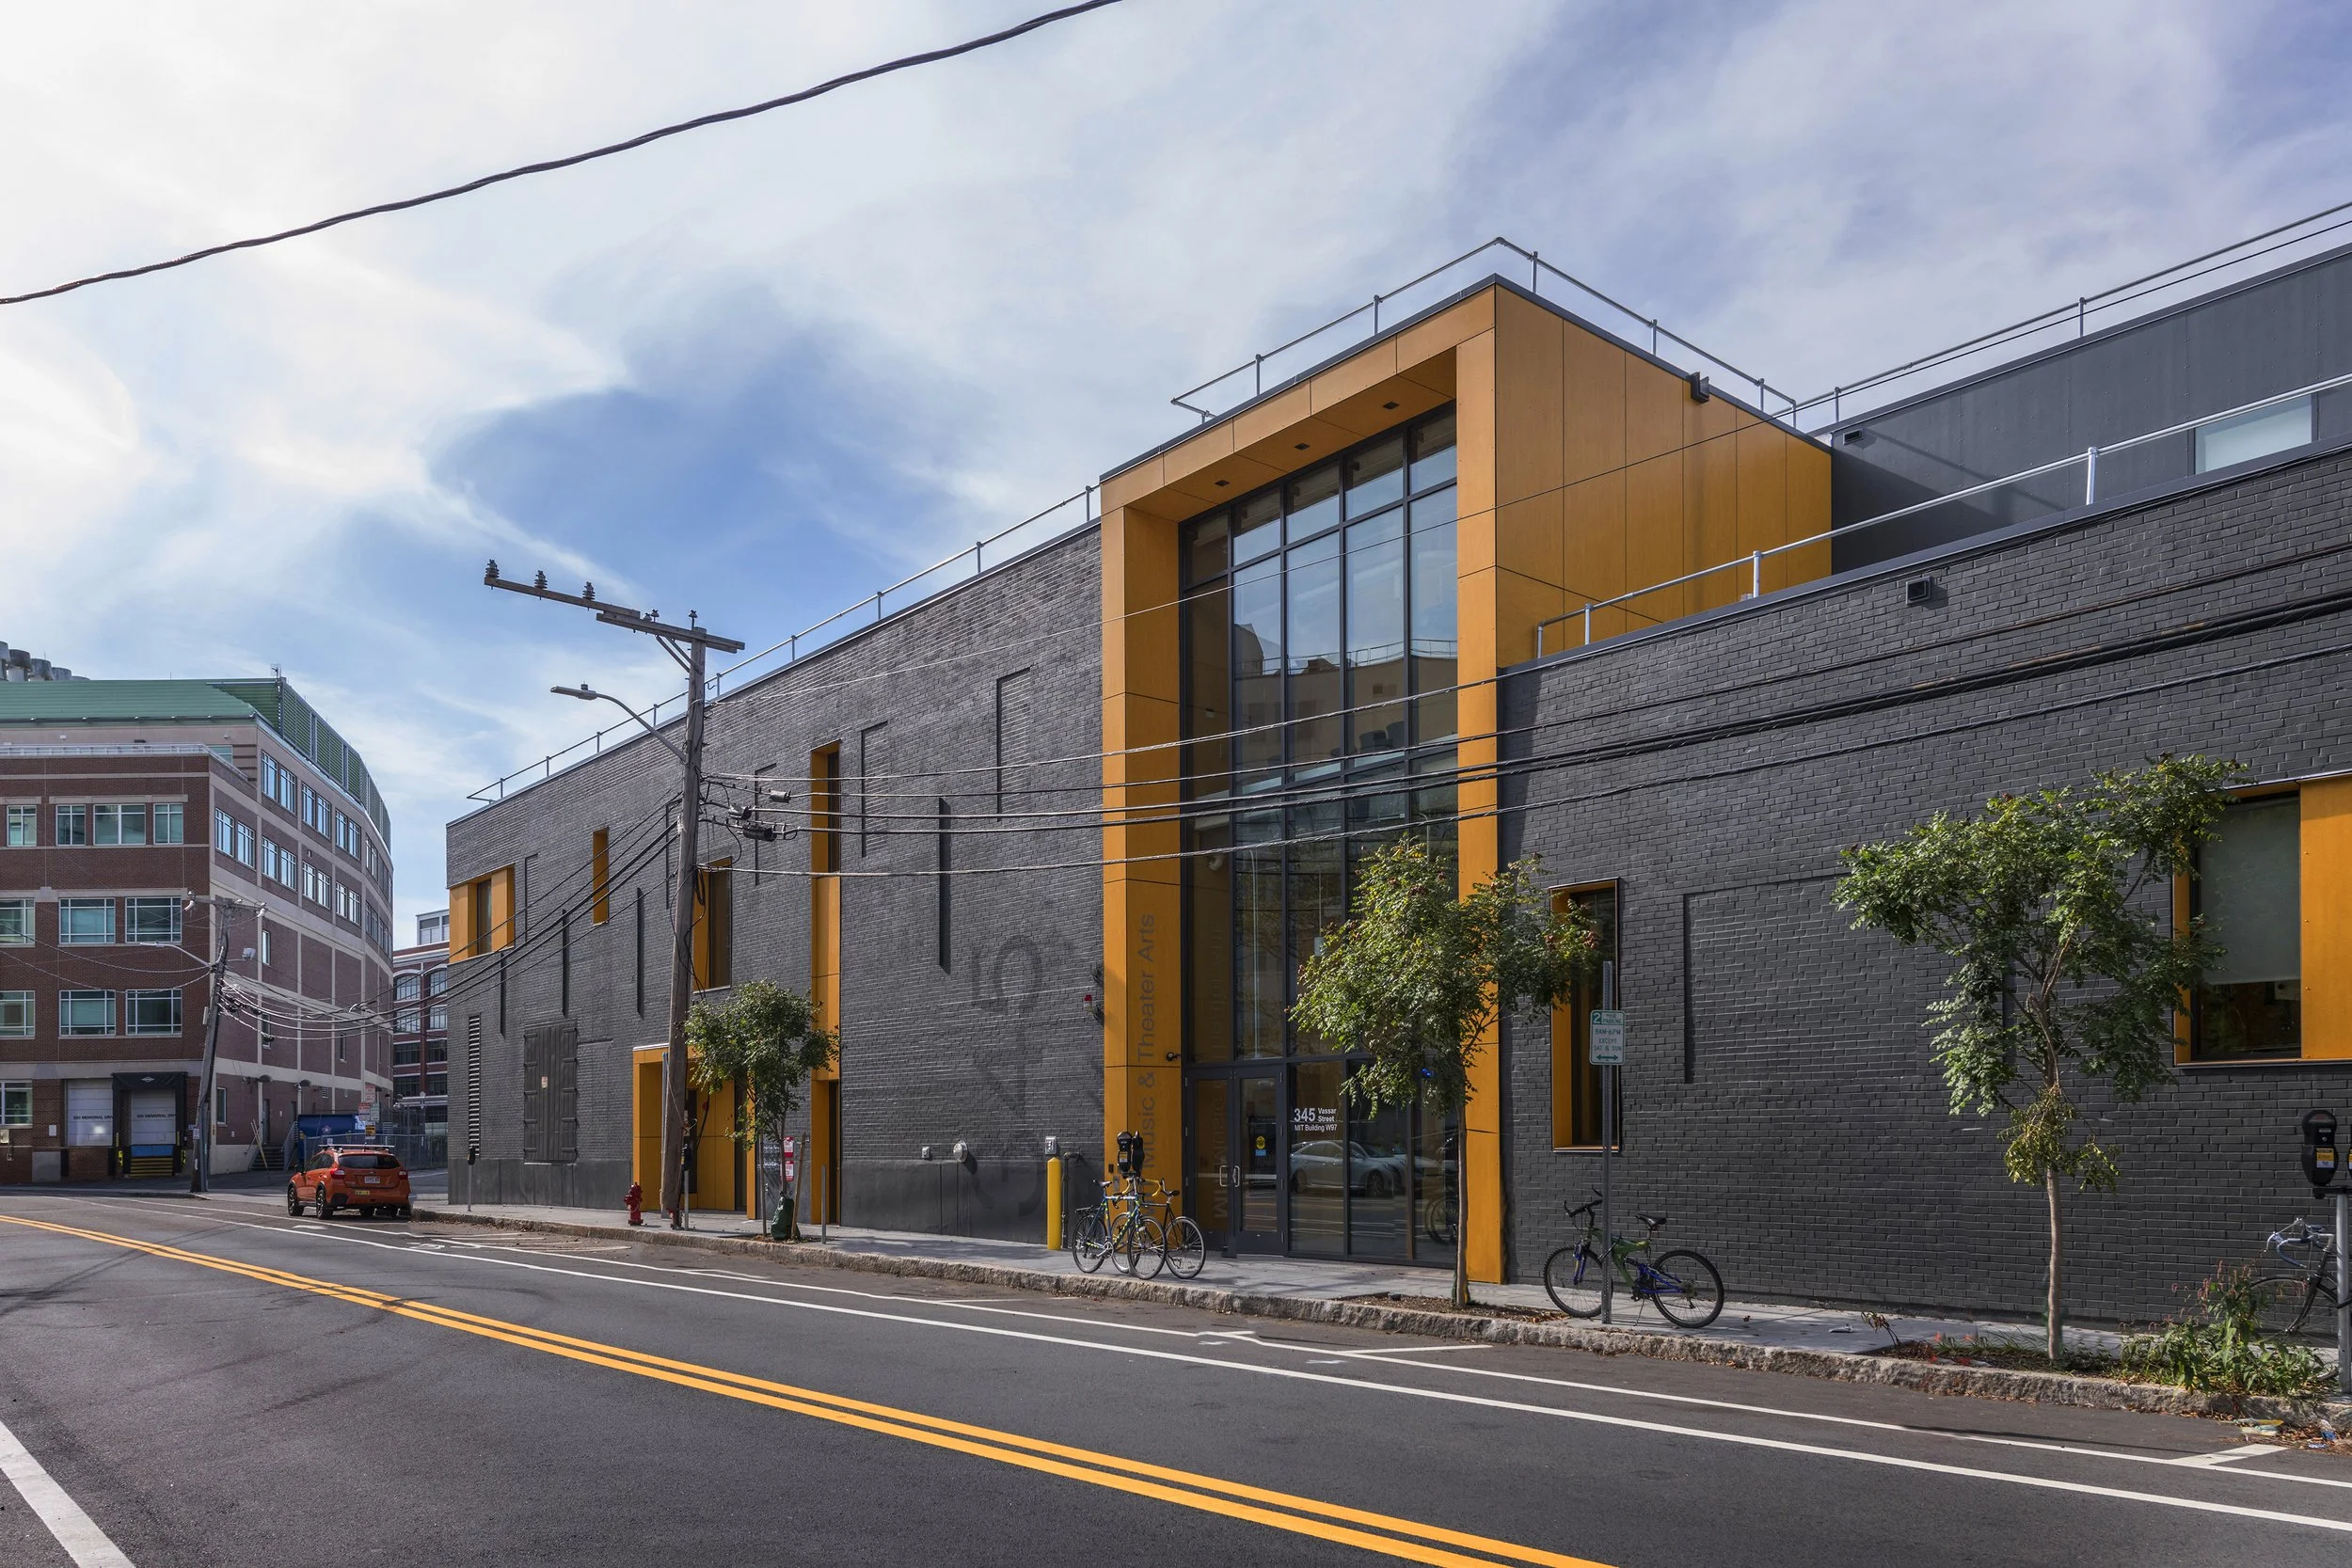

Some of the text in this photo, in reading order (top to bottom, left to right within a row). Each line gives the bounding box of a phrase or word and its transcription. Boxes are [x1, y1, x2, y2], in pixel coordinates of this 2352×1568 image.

[1137, 913, 1155, 963] Arts
[1137, 970, 1155, 1063] Theater
[1593, 1012, 1601, 1023] 2
[1137, 1071, 1155, 1088] &
[1294, 1107, 1315, 1122] 345
[1304, 1124, 1325, 1132] Building
